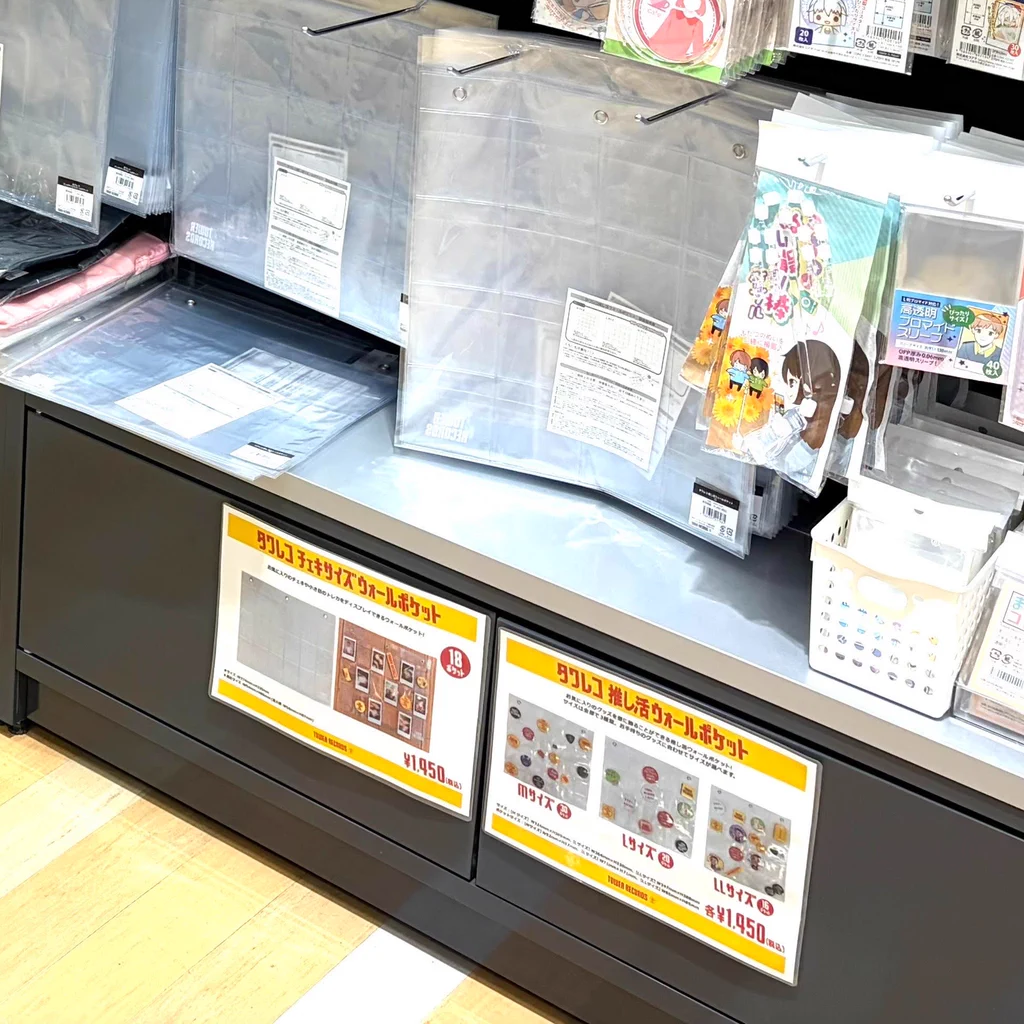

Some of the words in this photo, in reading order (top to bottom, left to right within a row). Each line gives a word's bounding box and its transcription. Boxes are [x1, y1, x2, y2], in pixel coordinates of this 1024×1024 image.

[900, 304, 937, 318] 高透明
[986, 362, 1000, 370] 40
[258, 530, 294, 564] タワレコ
[298, 550, 356, 590] チェキサイズ
[358, 576, 440, 624] ウォールポケット
[446, 664, 465, 678] ポケット
[448, 649, 462, 668] 18
[557, 662, 603, 699] タワレコ
[608, 684, 748, 760] 推し活ウォールポケット
[518, 783, 555, 811] Mサイズ
[622, 834, 656, 860] Lサイズ
[661, 854, 670, 862] 20
[608, 875, 624, 890] TOWER
[625, 884, 648, 901] RECORDS
[714, 878, 756, 908] LLサイズ
